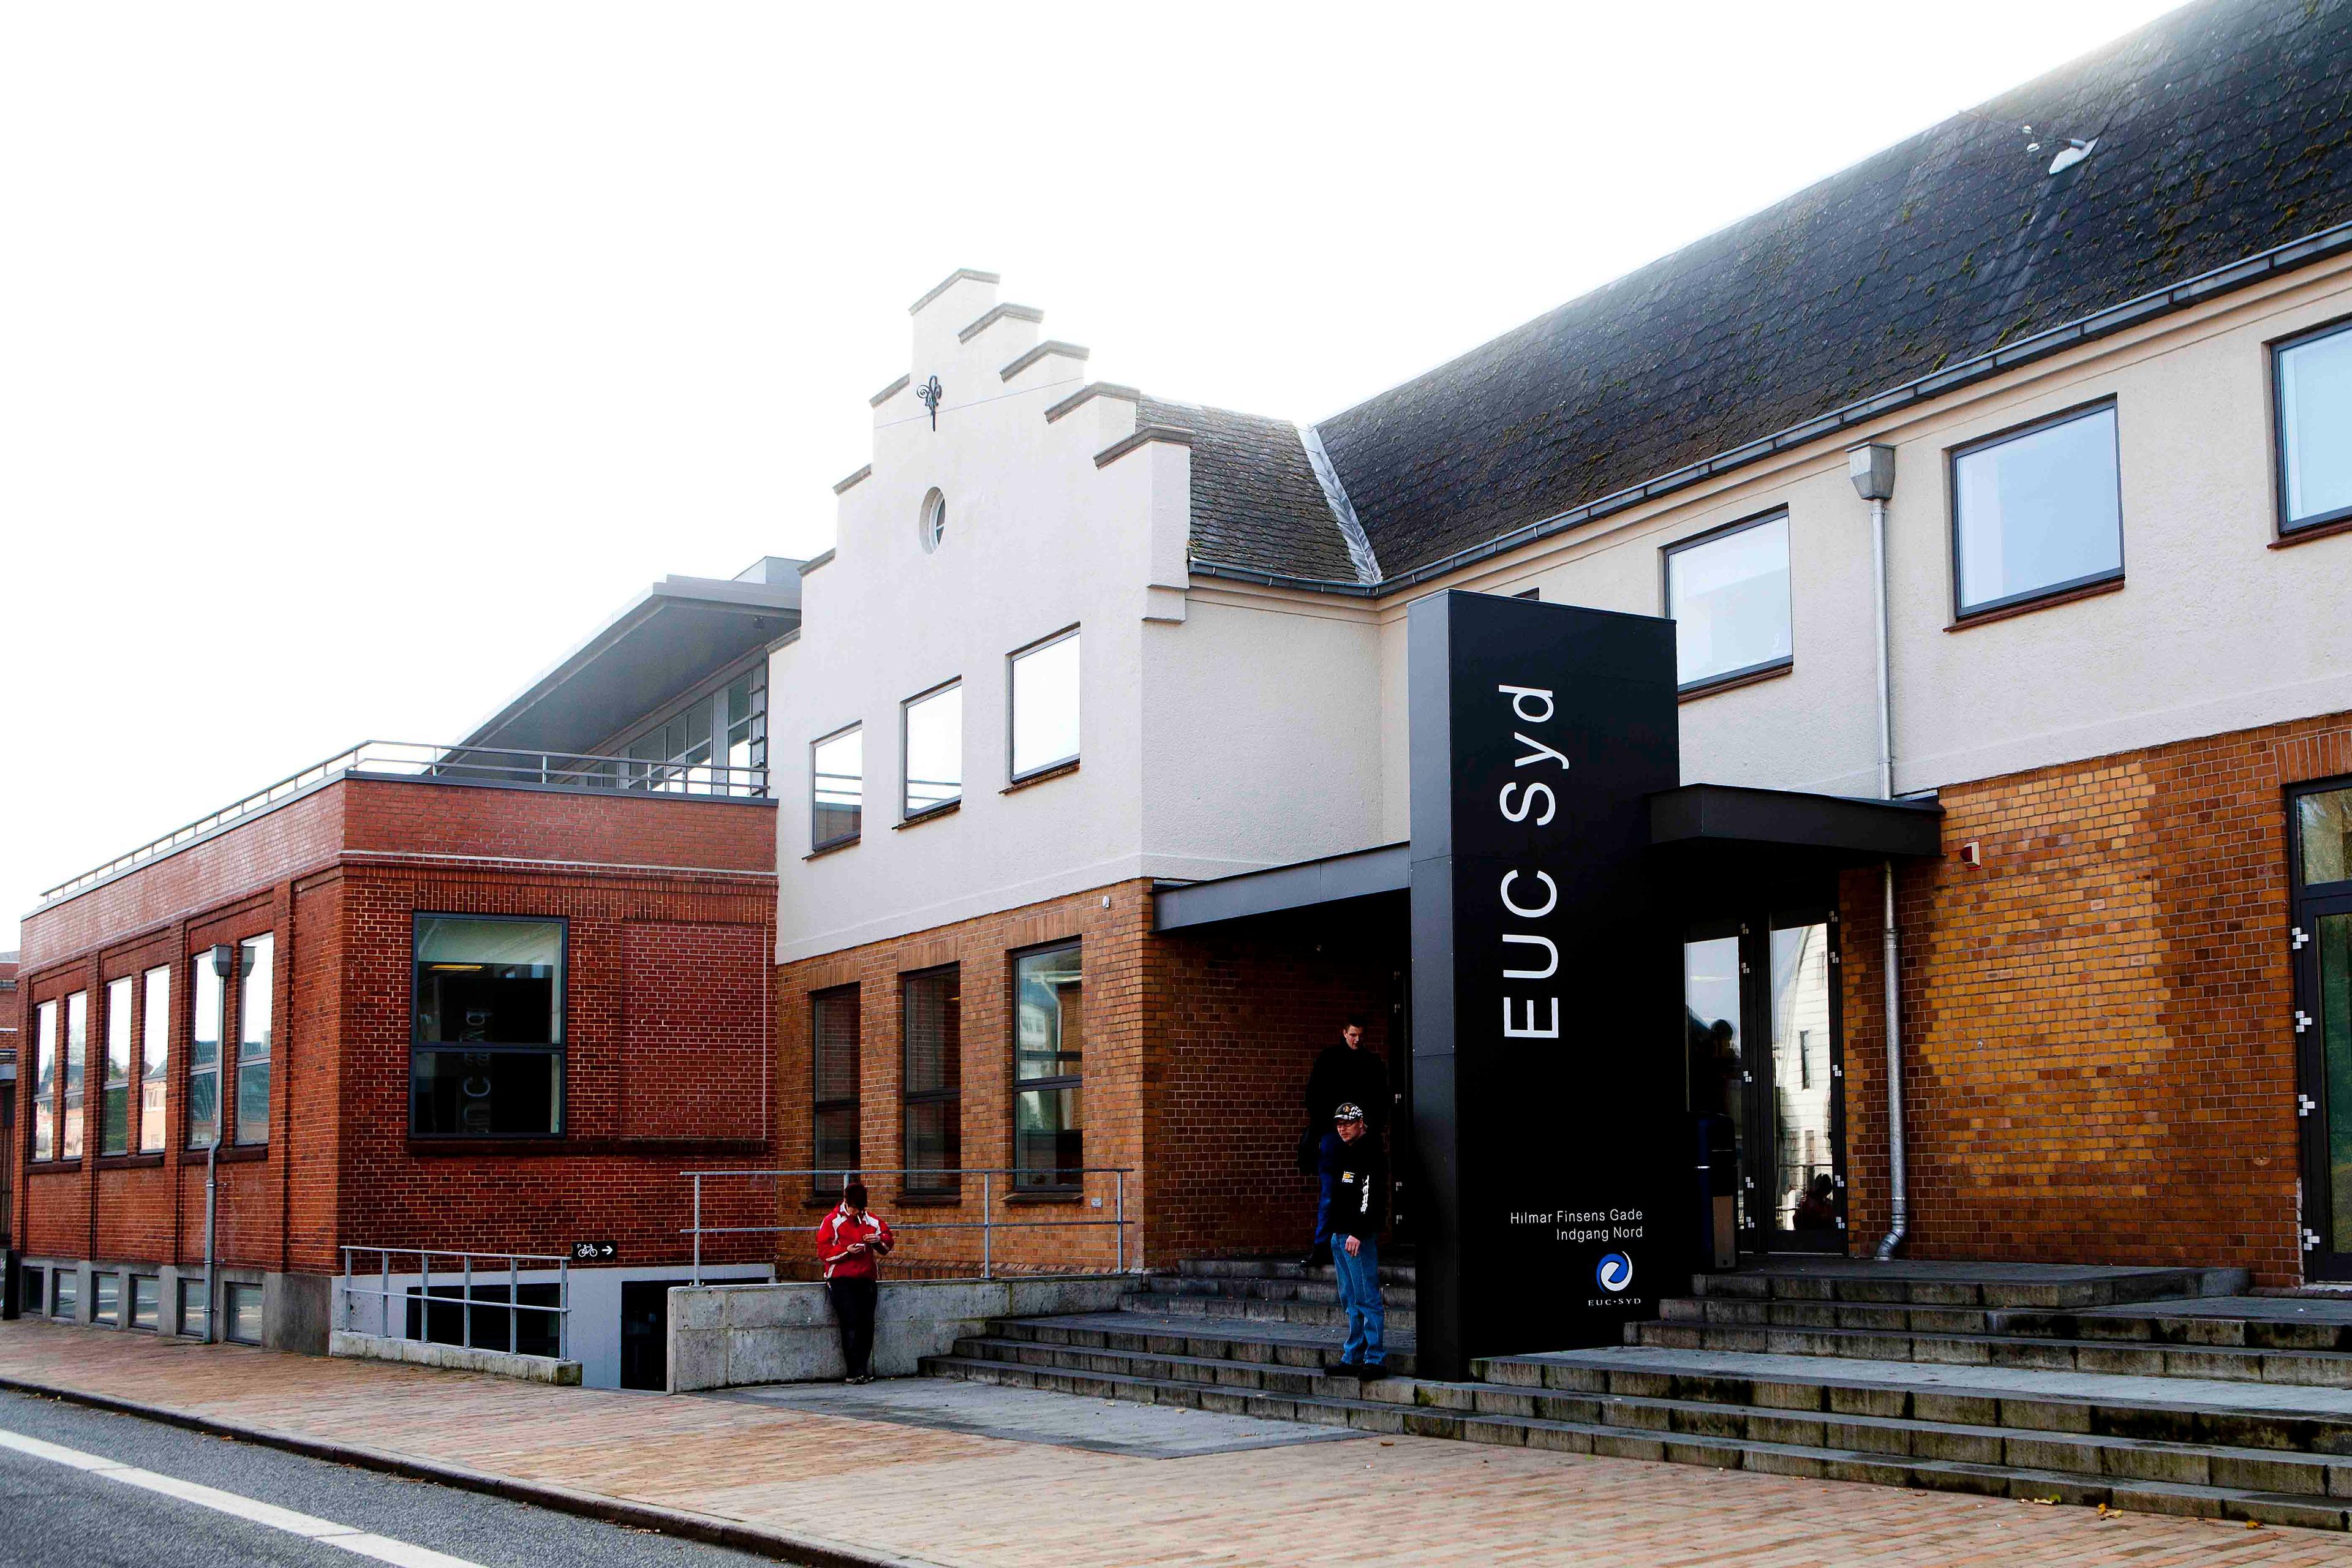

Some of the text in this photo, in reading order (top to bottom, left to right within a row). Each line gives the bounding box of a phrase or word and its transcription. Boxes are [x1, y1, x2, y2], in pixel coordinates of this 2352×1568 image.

[1498, 684, 1569, 1038] EUC Syd
[1510, 1208, 1643, 1224] Hilmar Finsens Gade
[1556, 1226, 1643, 1243] Indgang Nord
